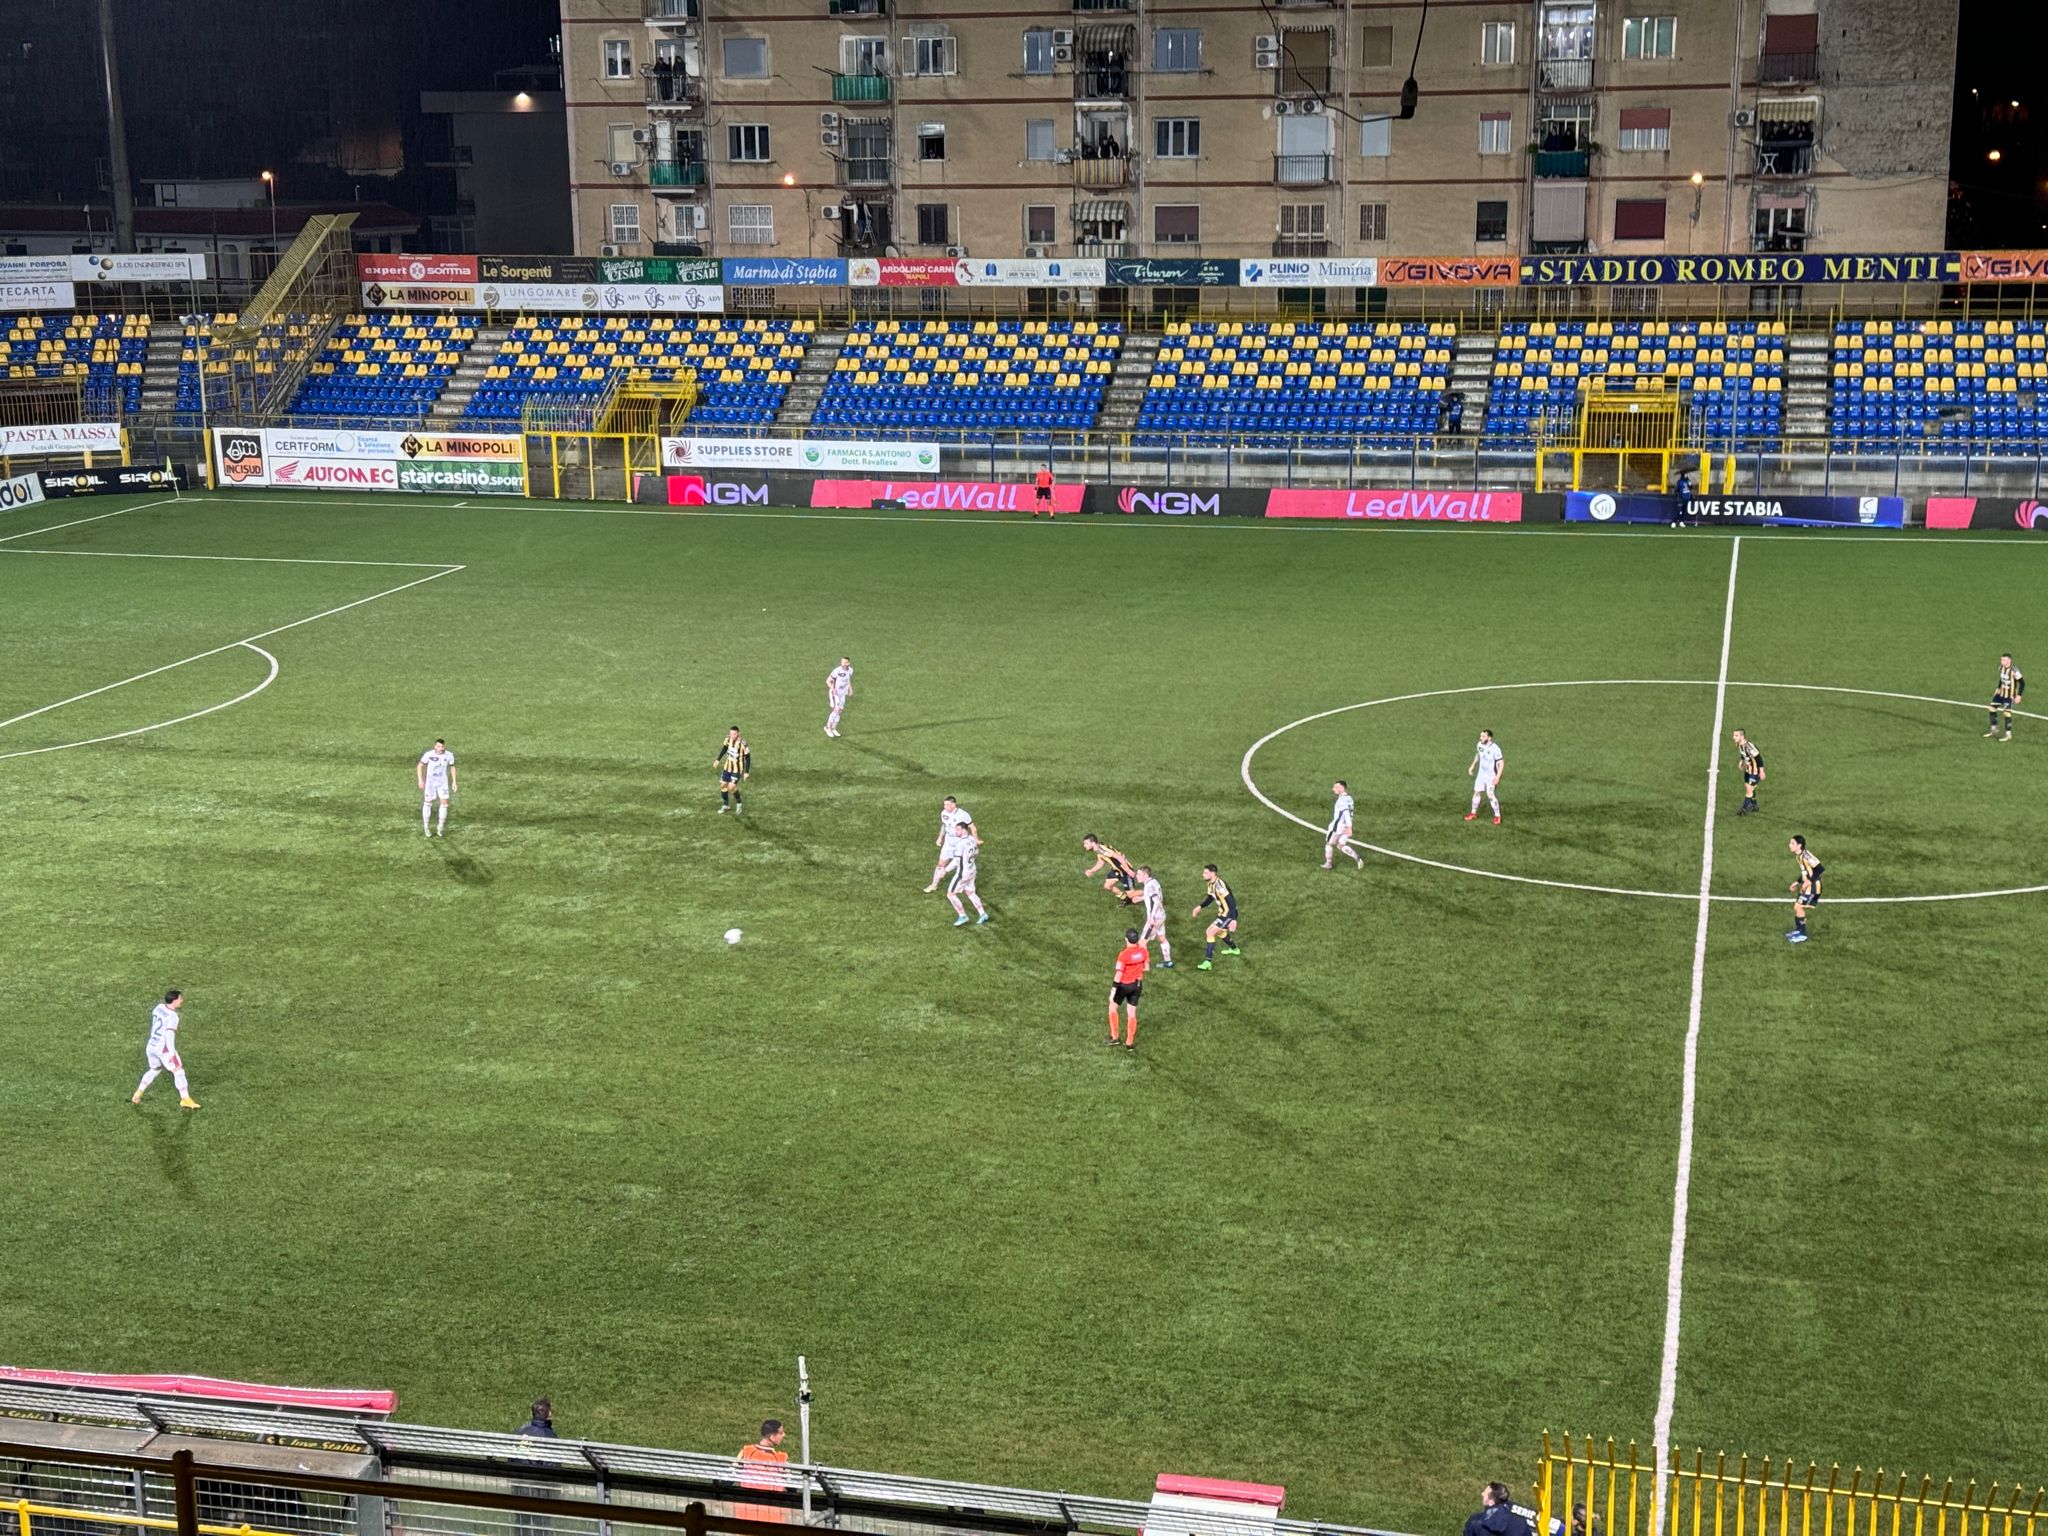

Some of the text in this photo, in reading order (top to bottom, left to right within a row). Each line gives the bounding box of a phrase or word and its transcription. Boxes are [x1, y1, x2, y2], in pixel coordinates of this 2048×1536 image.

[365, 266, 408, 276] expert
[427, 267, 471, 275] somma
[483, 265, 552, 280] Le Sorgenti
[608, 267, 644, 281] CESARI
[682, 268, 718, 282] CESARI
[734, 265, 777, 279] Marina
[780, 264, 793, 279] di
[797, 264, 838, 279] Stabia
[881, 265, 955, 273] ARDOLINO CARNI
[1119, 260, 1188, 278] Tiburon
[1319, 262, 1371, 276] Mimina
[1407, 264, 1511, 280] GIVOVA
[1539, 256, 1939, 282] STADIO ROMEO MENTI
[389, 290, 468, 301] LA MINOPOLI
[503, 287, 577, 297] LUNGOMARE
[6, 427, 117, 442] PASTA MASSA
[275, 441, 335, 452] CERTFORM
[426, 441, 513, 454] LA MINOPOLI
[697, 445, 793, 457] SUPPLIES STORE
[827, 448, 867, 457] FARMACIA
[226, 465, 261, 474] INCISUD
[862, 458, 898, 467] Ravallese
[303, 466, 395, 483] AUTOMEC
[684, 482, 769, 505] NGM
[883, 484, 1016, 509] LedWall
[1131, 491, 1219, 515] NGM
[1346, 493, 1492, 519] LedWall
[1687, 501, 1783, 516] UVE STABIA
